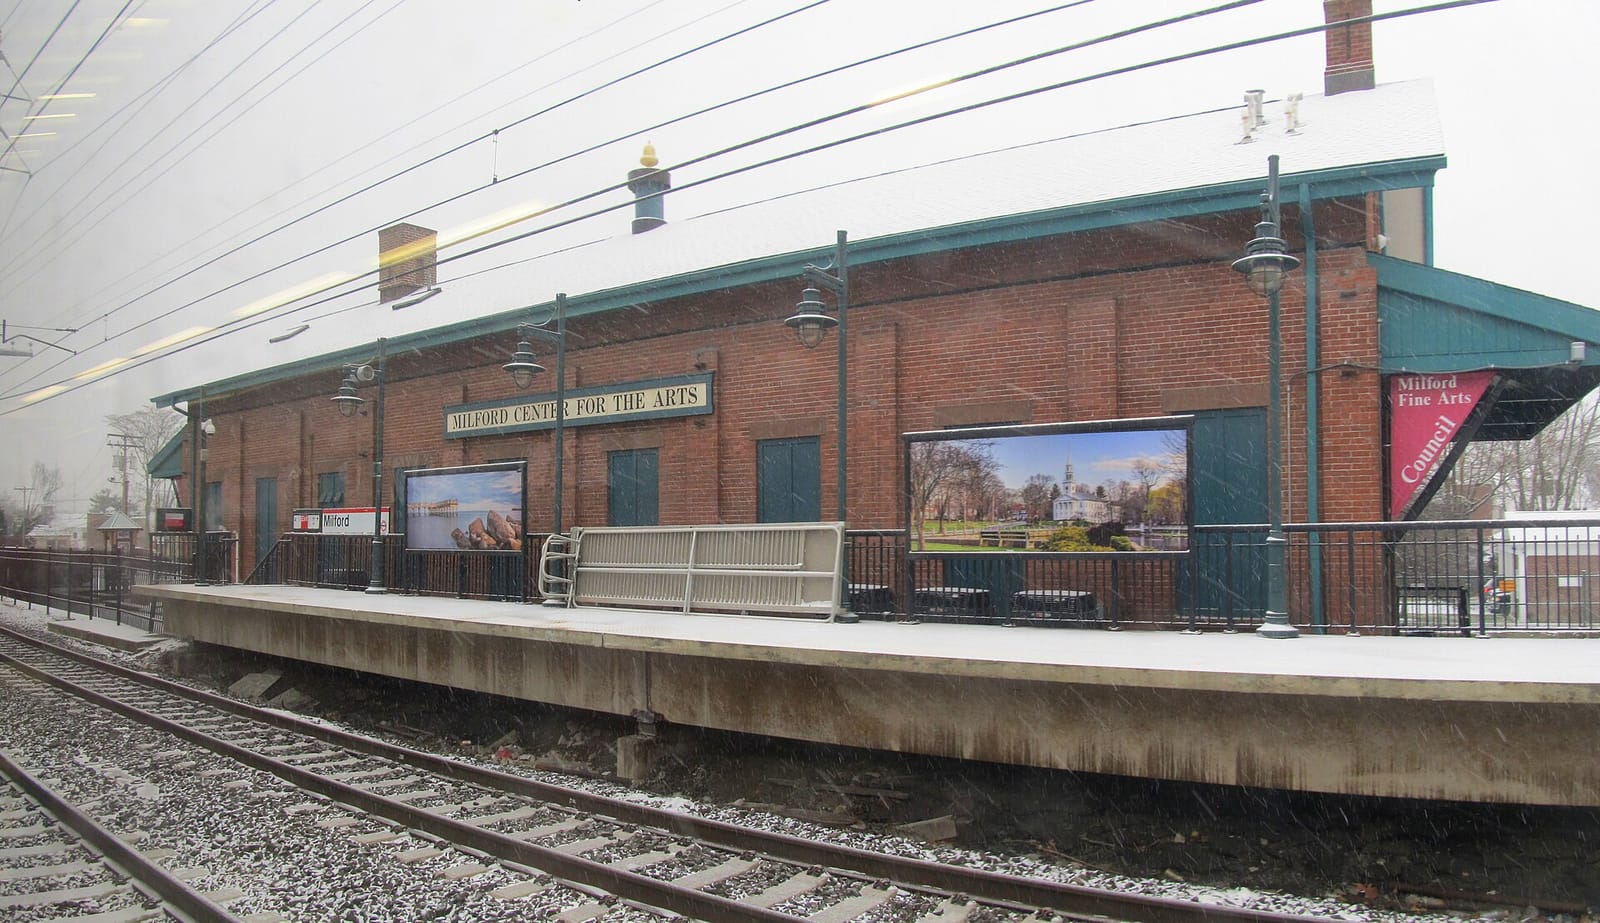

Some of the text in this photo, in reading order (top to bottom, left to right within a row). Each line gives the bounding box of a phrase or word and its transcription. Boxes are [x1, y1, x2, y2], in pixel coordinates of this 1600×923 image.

[1398, 376, 1457, 391] Milford
[1398, 392, 1472, 407] Fine Arts
[452, 407, 508, 430] MILFORD
[576, 396, 606, 416] FOR
[613, 391, 646, 412] THE
[653, 386, 698, 408] ARTS
[1401, 415, 1457, 484] Council
[323, 514, 350, 527] Milford
